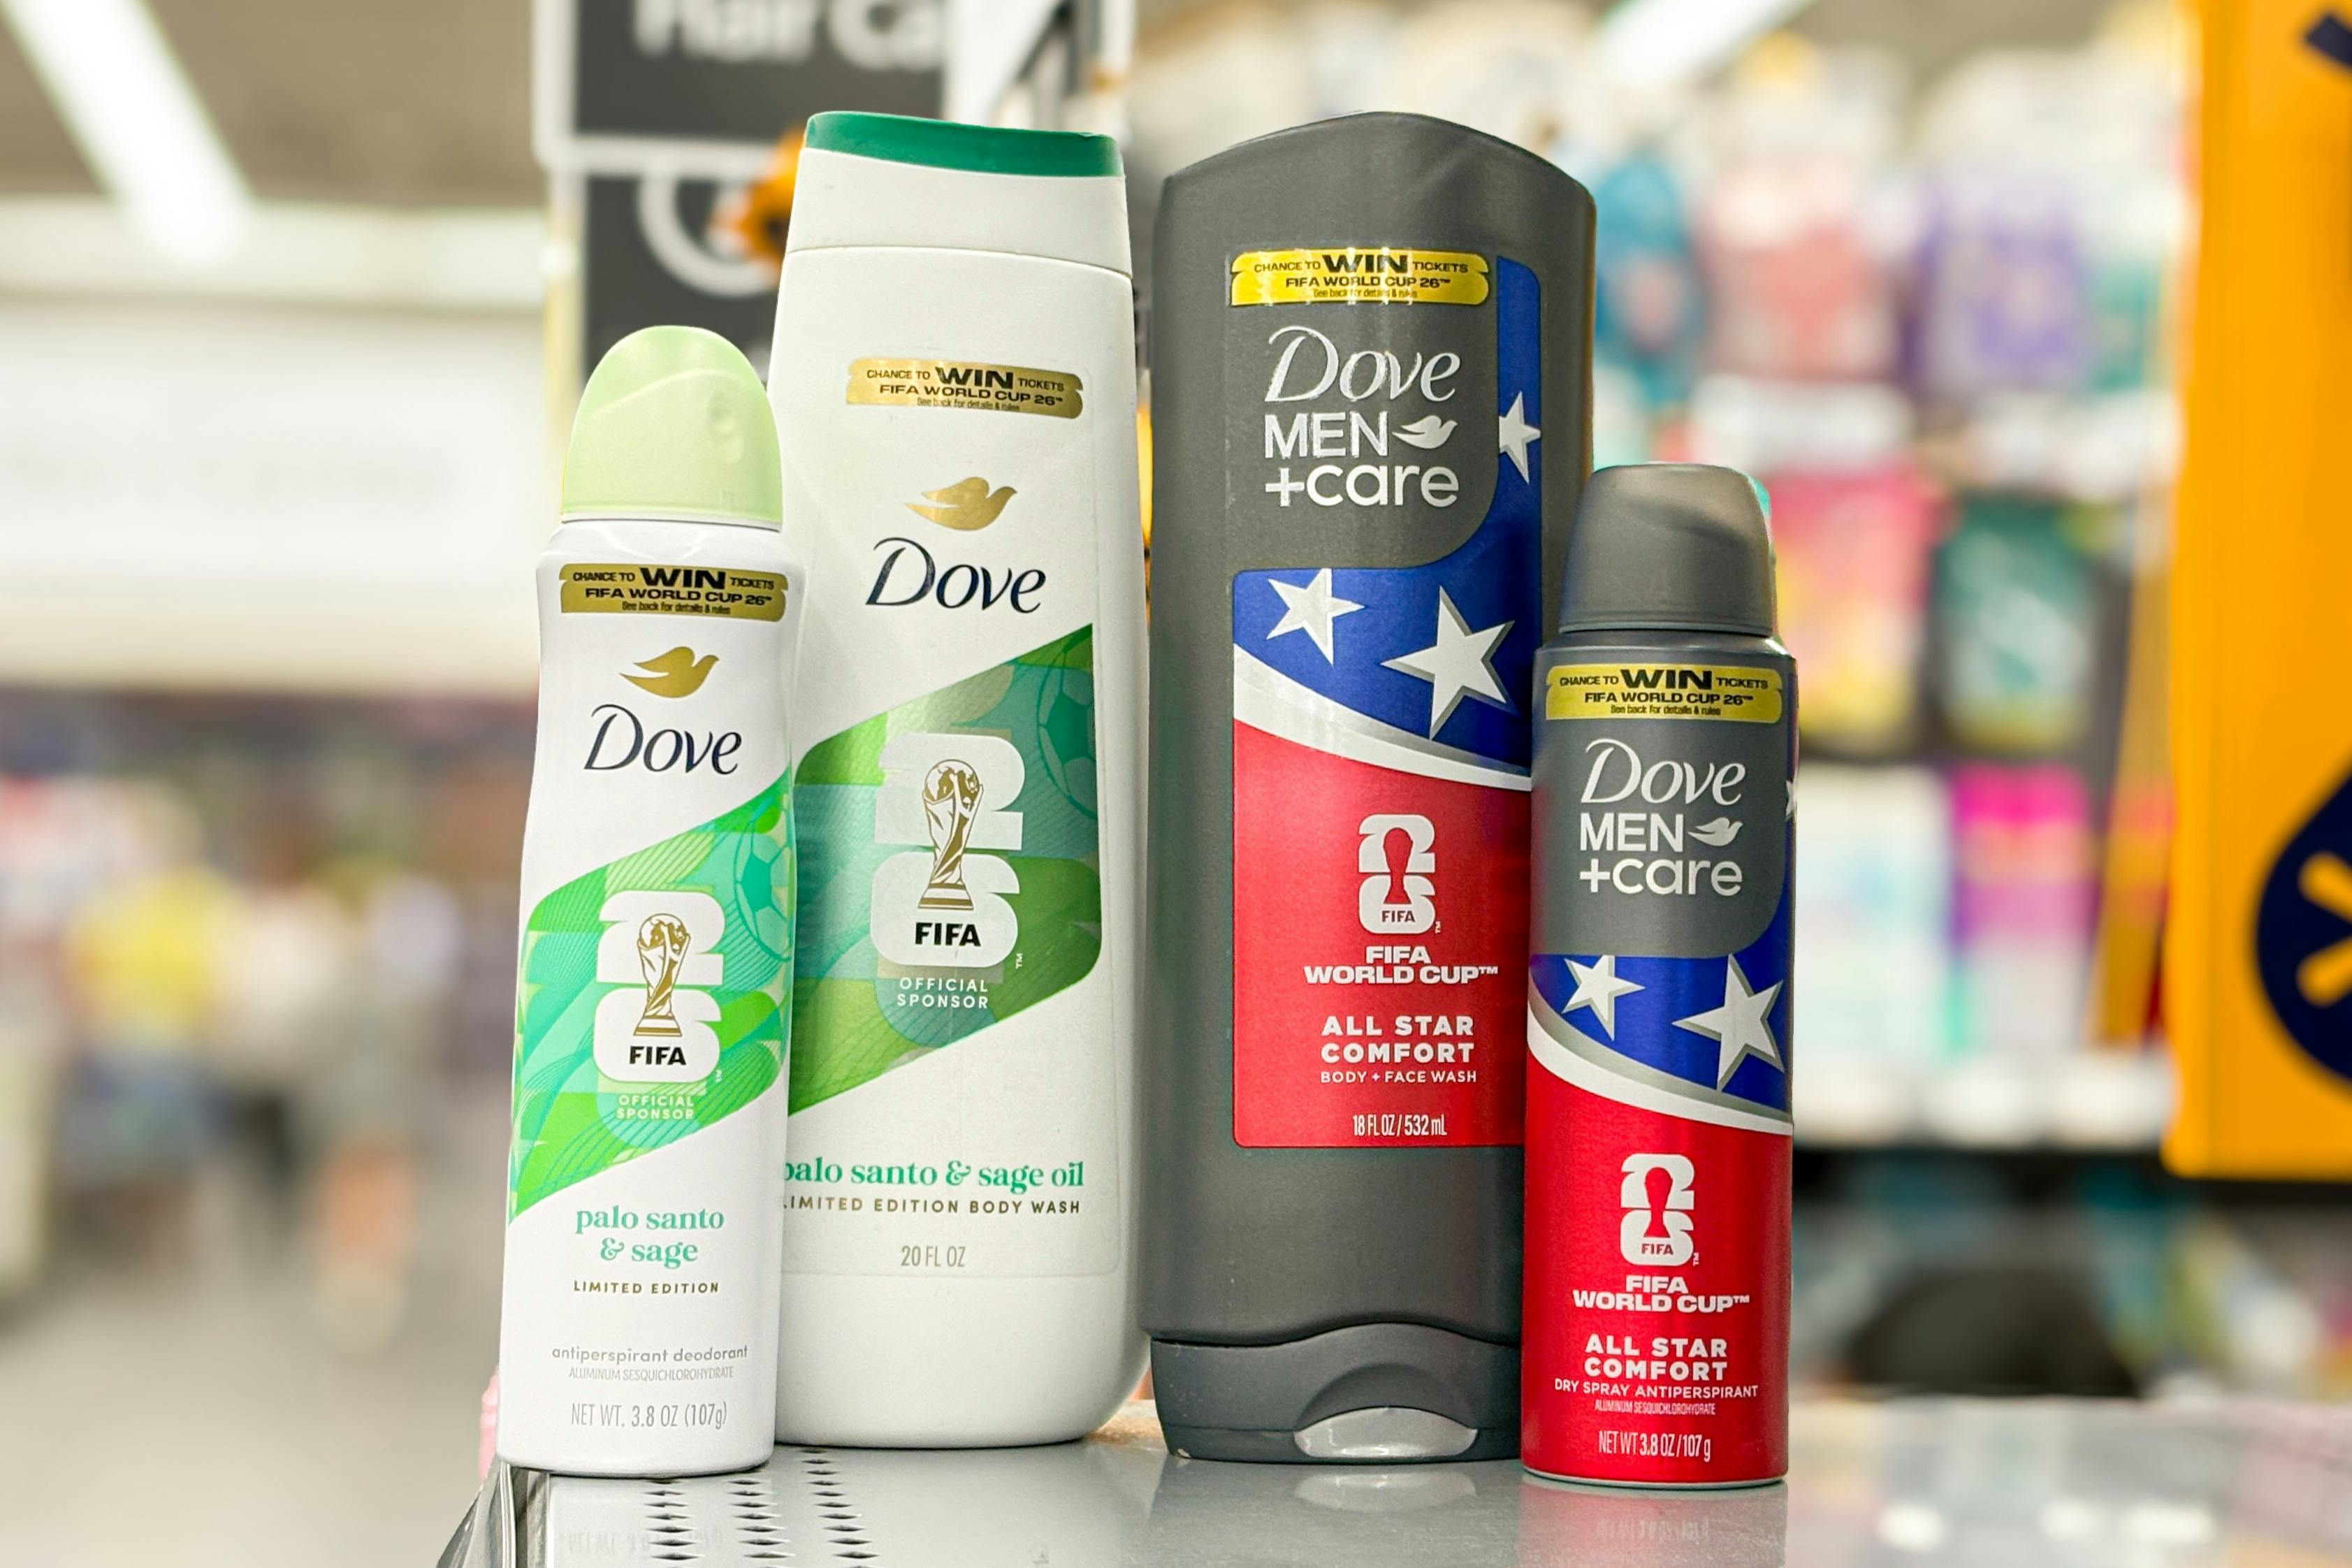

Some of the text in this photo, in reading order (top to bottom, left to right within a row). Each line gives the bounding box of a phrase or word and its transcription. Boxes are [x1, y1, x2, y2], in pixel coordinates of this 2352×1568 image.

[1254, 254, 1468, 273] CHANCE TO WIN TICKETS
[1286, 277, 1319, 288] FIFA
[1323, 276, 1380, 287] WORLD
[1384, 276, 1417, 287] CUP
[1329, 288, 1348, 297] back
[1391, 289, 1397, 297] &
[1264, 325, 1461, 402] Dove
[866, 366, 1065, 391] CHANCE TO WIN TICKETS
[880, 384, 919, 395] FIFA
[924, 386, 991, 399] WORLD
[995, 390, 1031, 402] CUP
[917, 397, 931, 407] See
[954, 399, 964, 408] for
[1264, 411, 1388, 459] MEN
[1265, 464, 1459, 508] +care
[573, 567, 774, 590] CHANCE TO WIN TICKETS
[866, 537, 1046, 614] Dove
[585, 588, 625, 599] FIFA
[629, 588, 701, 601] WORLD
[705, 591, 742, 603] CUP
[622, 601, 637, 611] See
[639, 602, 658, 611] back
[661, 602, 673, 612] for
[674, 603, 703, 614] details
[704, 605, 711, 614] &
[1560, 669, 1768, 690] CHANCE TO WIN TICKETS
[1585, 692, 1618, 703] FIFA
[1621, 692, 1683, 703] WORLD
[1686, 693, 1721, 704] CUP
[1611, 704, 1721, 716] See back for details & rules
[583, 703, 742, 775] Dove
[1581, 738, 1746, 806] Dove
[1580, 812, 1684, 852] MEN
[1579, 858, 1743, 896] +care
[1381, 910, 1416, 923] FIFA
[915, 922, 981, 947] FIFA
[1365, 945, 1431, 964] FIFA
[899, 977, 988, 992] OFFICIAL
[1304, 965, 1414, 985] WORLD
[897, 993, 988, 1009] SPONSOR
[1321, 1015, 1474, 1036] ALL STAR
[629, 1045, 687, 1066] FIFA
[1321, 1043, 1474, 1064] COMFORT
[1320, 1070, 1367, 1083] BODY
[1385, 1070, 1427, 1083] FACE
[1431, 1070, 1476, 1083] WASH
[619, 1095, 695, 1106] OFFICIAL
[616, 1108, 695, 1119] SPONSOR
[1353, 1114, 1365, 1136] 18
[1367, 1114, 1380, 1136] FL
[1404, 1114, 1429, 1136] 532
[1431, 1114, 1447, 1136] mL
[850, 1163, 937, 1186] santo
[945, 1160, 971, 1186] &
[978, 1165, 1044, 1195] sage
[1051, 1161, 1084, 1186] oil
[783, 1196, 1080, 1214] IMITED EDITION BODY WASH
[575, 1205, 725, 1235] palo santo
[600, 1237, 698, 1270] & sage
[901, 1245, 966, 1268] 20 FL OZ
[1641, 1243, 1674, 1256] FIFA
[574, 1280, 719, 1294] LIMITED EDITION
[1625, 1275, 1688, 1294] FIFA
[1572, 1290, 1672, 1312] WORLD
[552, 1345, 748, 1365] antiperspirant deodorant
[1585, 1333, 1727, 1358] ALL STAR
[569, 1366, 734, 1381] ALUMINUM SESQUICHLOROHYDRATE
[1584, 1358, 1728, 1381] COMFORT
[1555, 1378, 1759, 1399] DRY SPRAY ANTIPERSPIRANT
[572, 1401, 727, 1430] NET WT. 3.8 OZ (107g)
[1595, 1399, 1715, 1416] ALUMINUM SESQUICHLOROHYDRATE
[1599, 1430, 1619, 1454] NET
[1620, 1432, 1639, 1456] WT
[1639, 1432, 1658, 1456] 3.8
